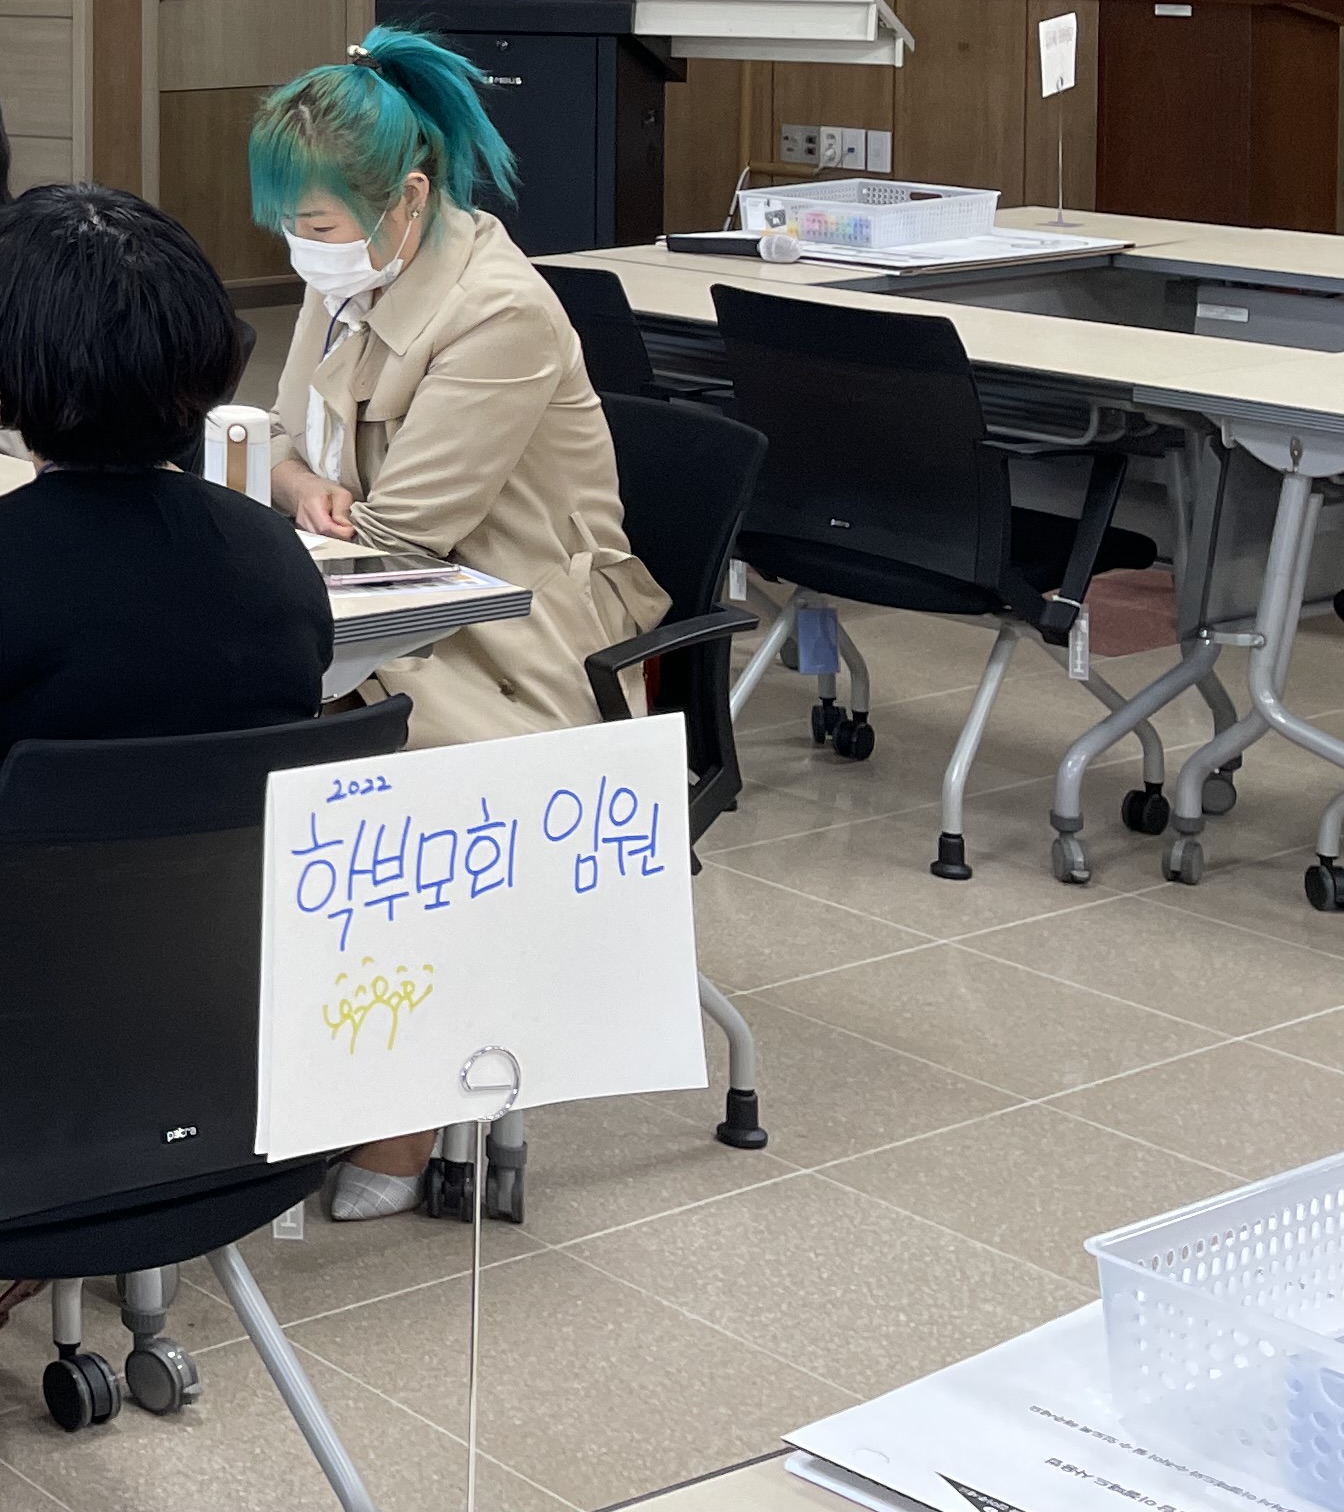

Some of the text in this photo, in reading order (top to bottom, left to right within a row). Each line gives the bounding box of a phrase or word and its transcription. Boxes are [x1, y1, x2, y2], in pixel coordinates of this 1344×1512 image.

[326, 776, 393, 803] 2022
[291, 775, 665, 951] 학부모회 임원
